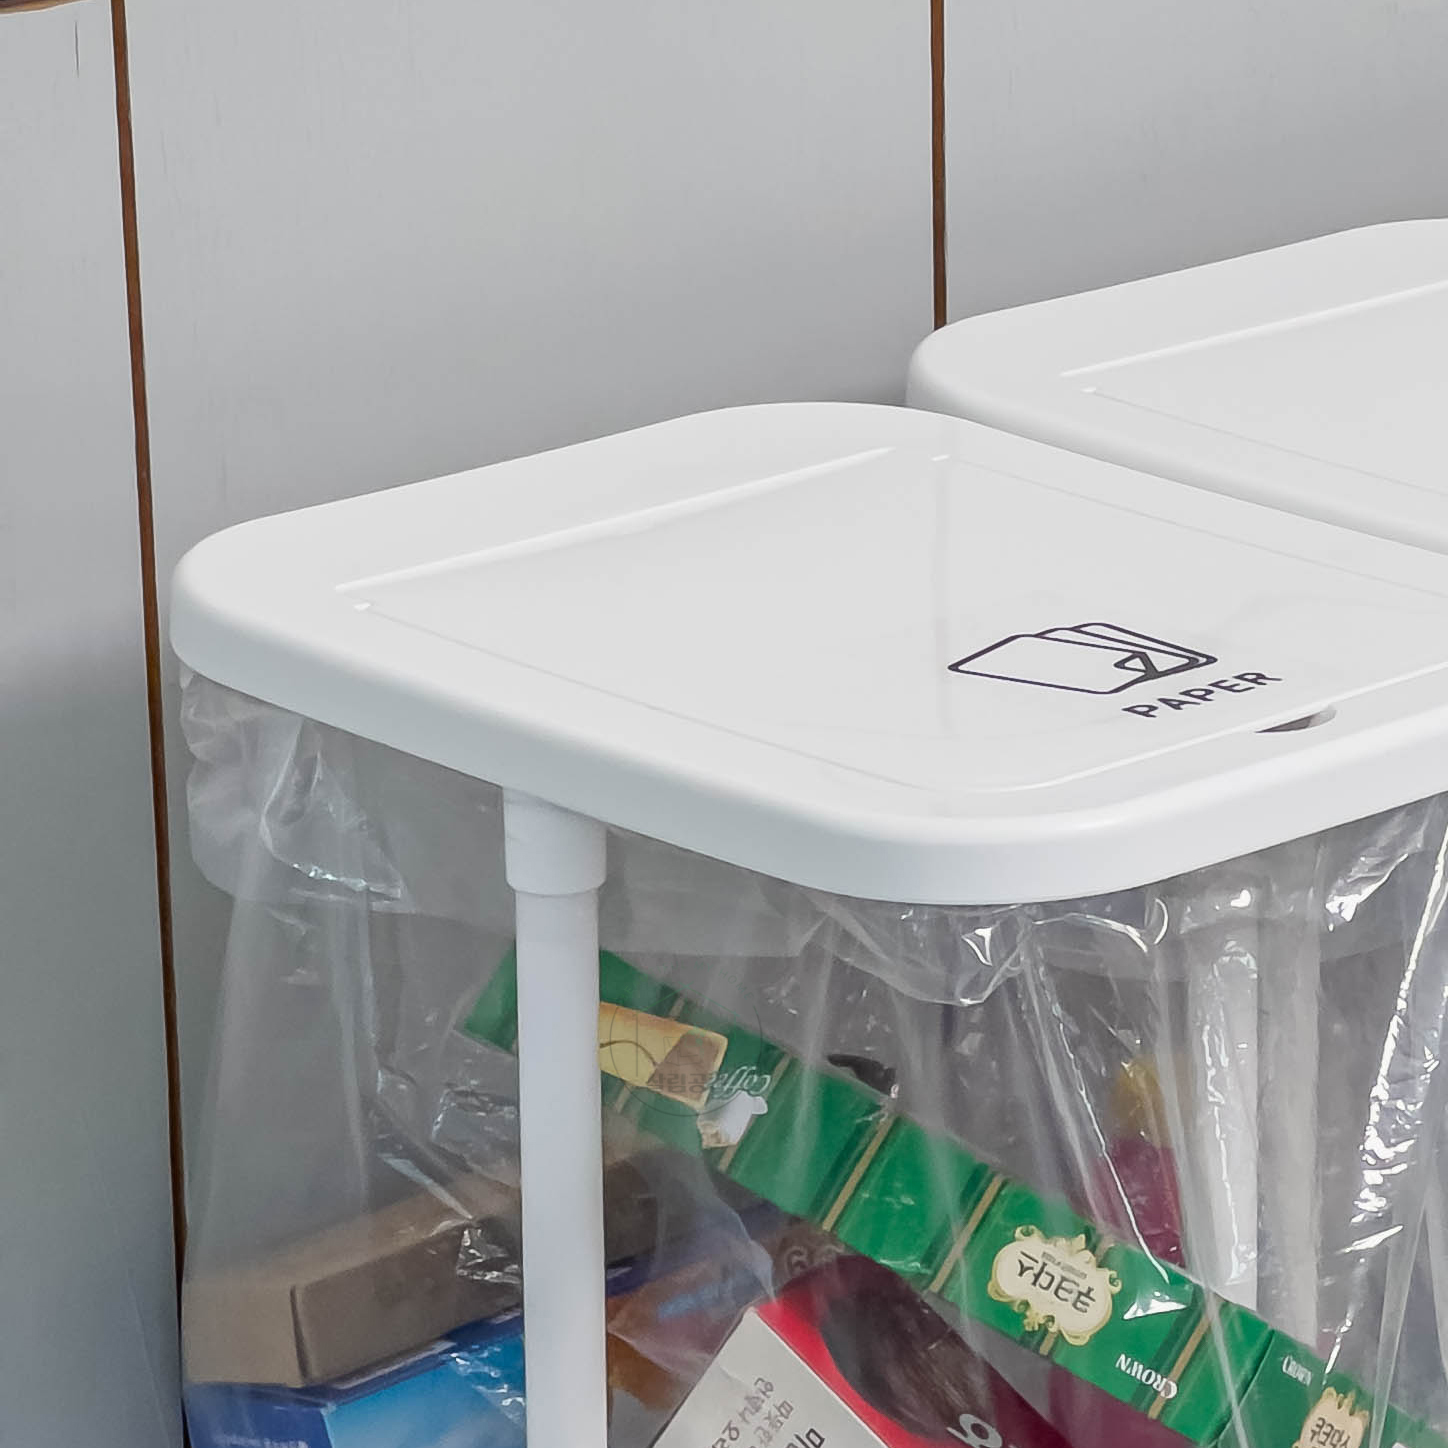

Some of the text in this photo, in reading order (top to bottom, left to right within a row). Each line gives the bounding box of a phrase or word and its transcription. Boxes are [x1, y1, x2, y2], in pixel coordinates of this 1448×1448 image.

[1121, 671, 1283, 719] PAPER
[1015, 1250, 1097, 1316] 쿠크다스
[1114, 1351, 1179, 1400] CROWN
[1281, 1354, 1314, 1387] CROWN
